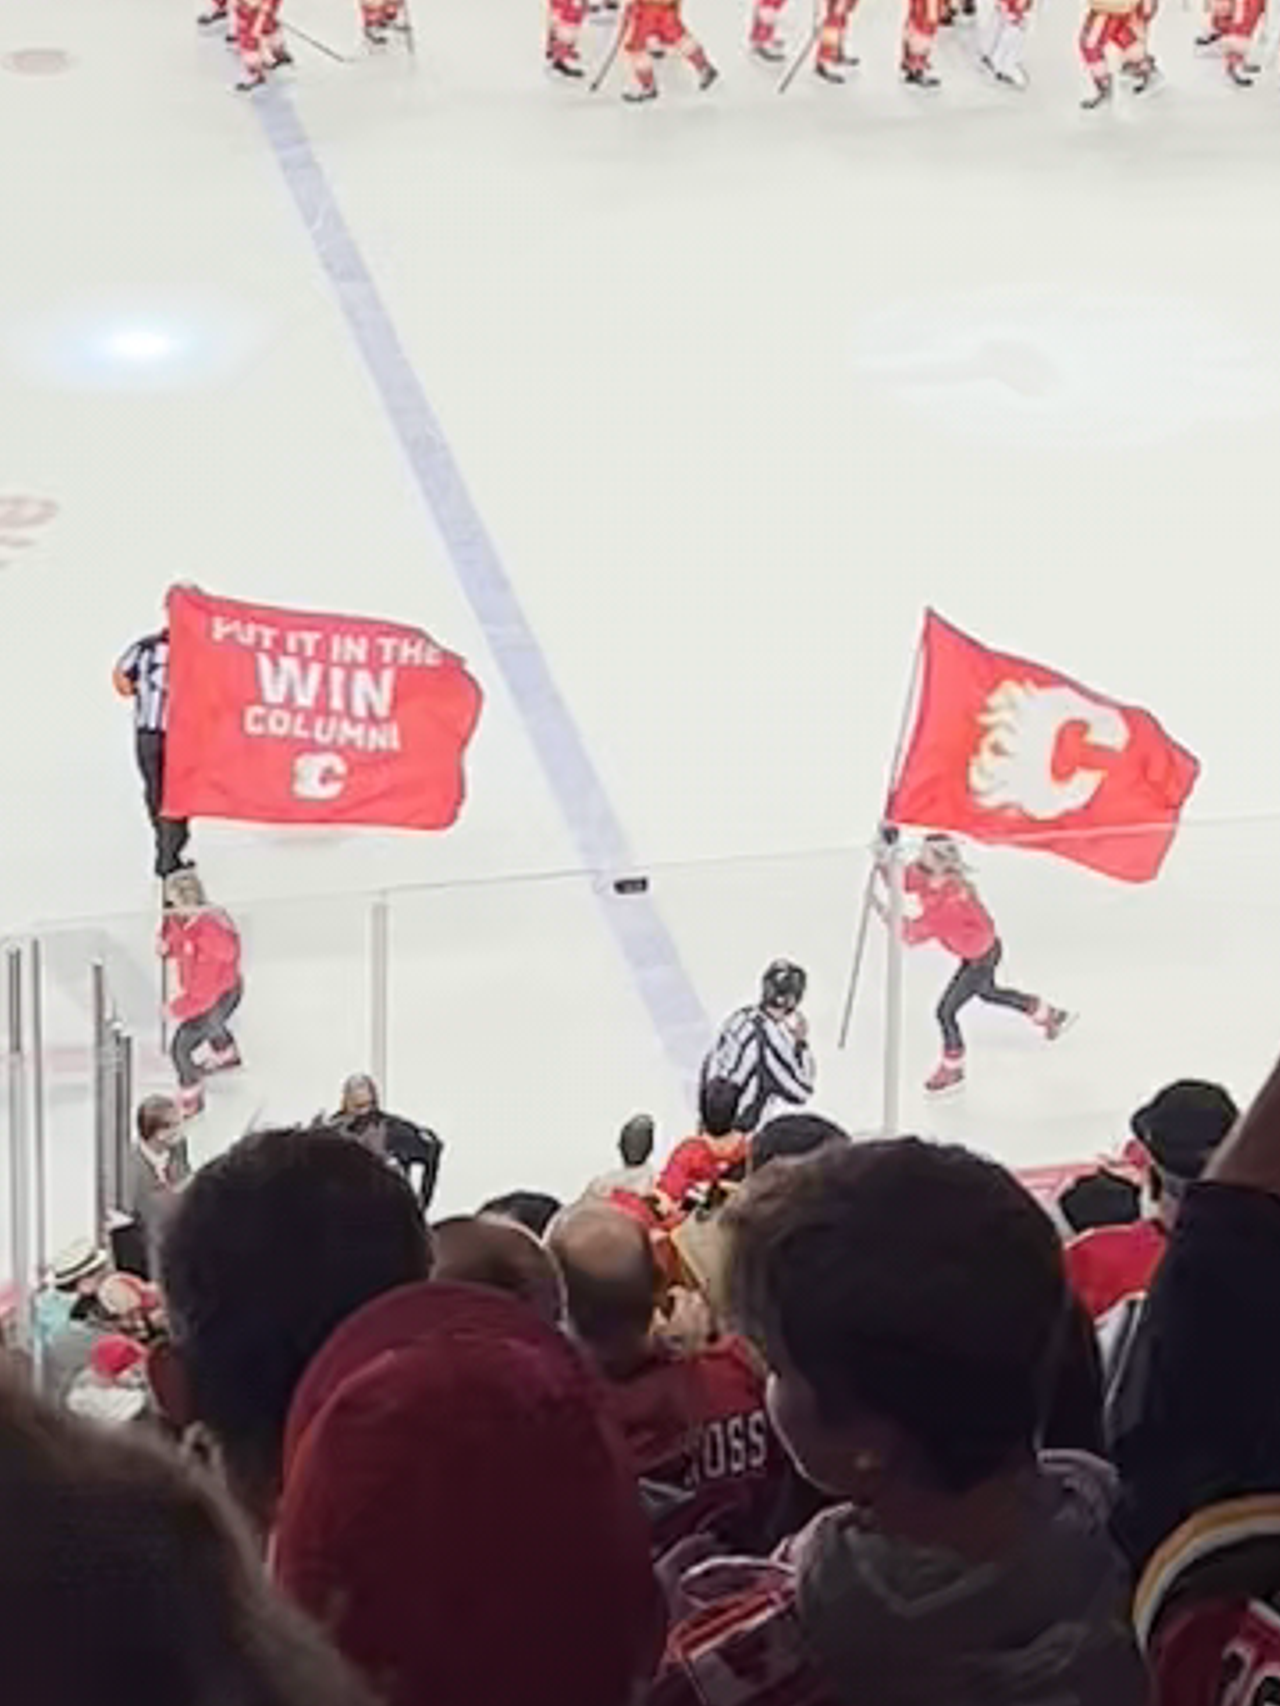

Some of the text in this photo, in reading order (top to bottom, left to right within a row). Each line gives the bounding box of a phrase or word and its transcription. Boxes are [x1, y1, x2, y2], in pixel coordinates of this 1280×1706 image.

[211, 616, 442, 667] PUT IT IN THE
[256, 651, 397, 719] WIN
[684, 1410, 768, 1486] OSS
